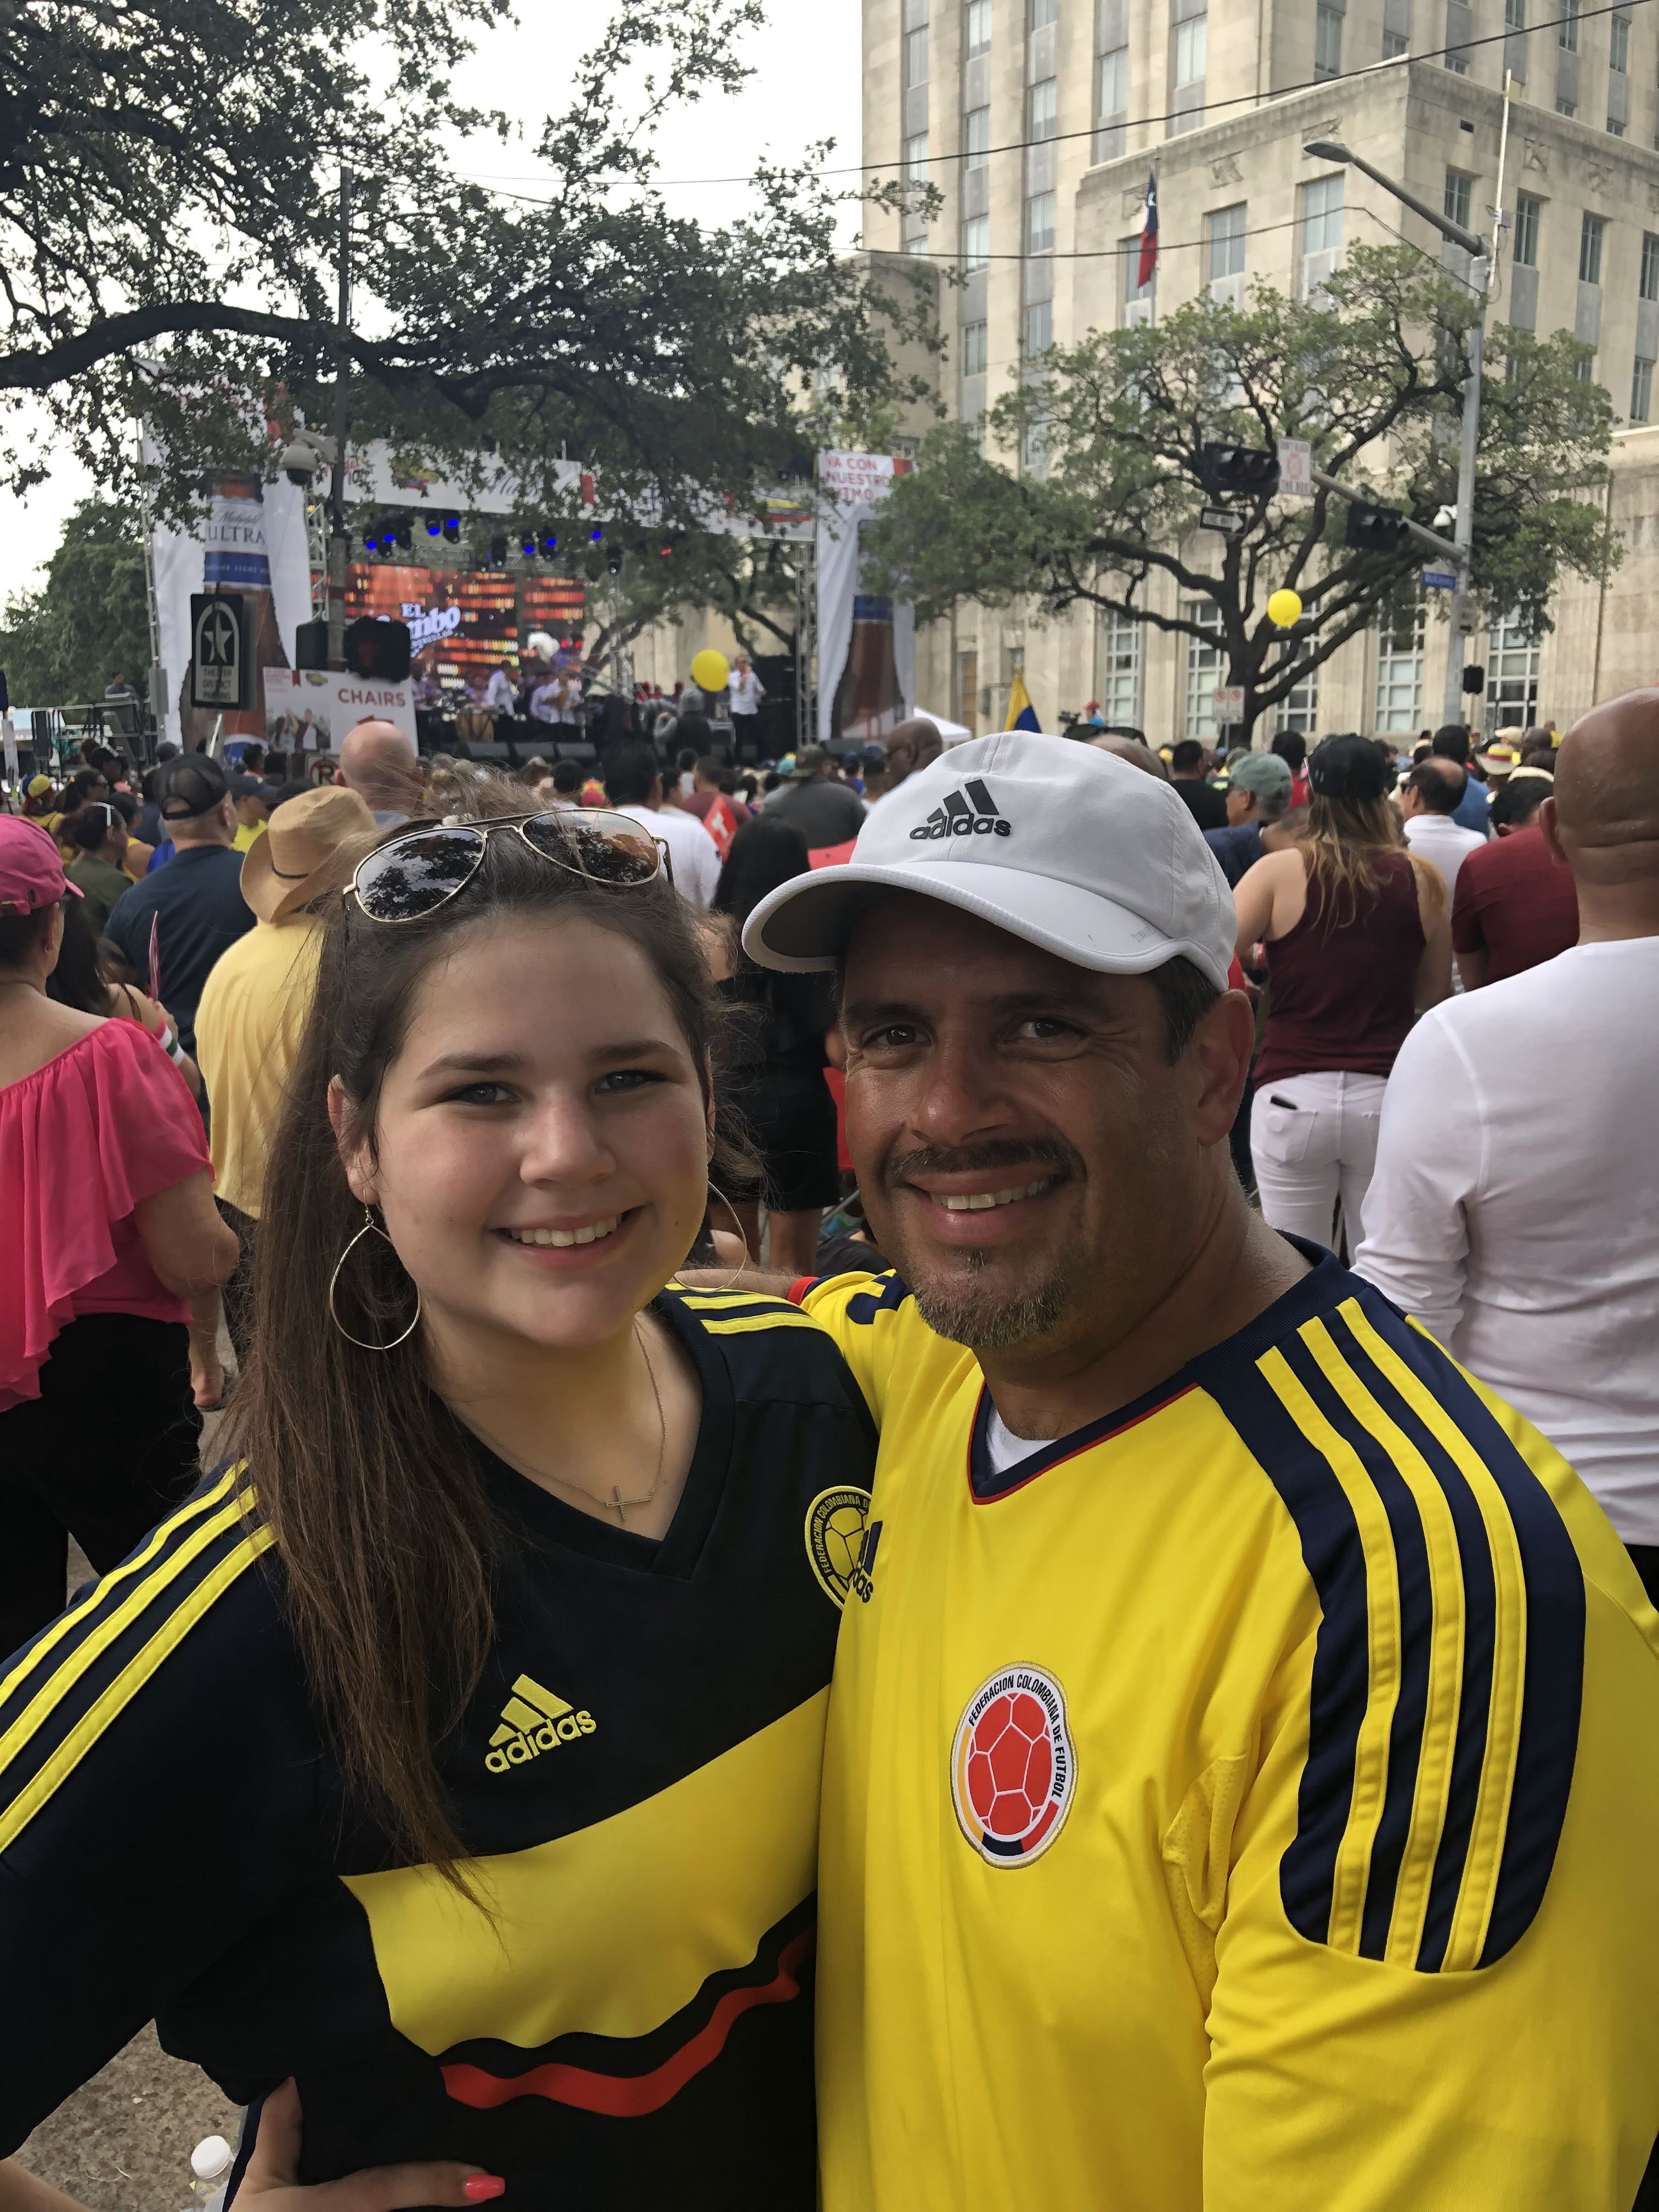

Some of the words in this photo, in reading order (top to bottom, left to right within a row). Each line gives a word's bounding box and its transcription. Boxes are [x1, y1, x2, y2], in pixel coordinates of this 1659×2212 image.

[847, 457, 878, 471] CON
[206, 525, 266, 545] ULTRA
[401, 602, 426, 618] EL
[338, 687, 406, 708] CHAIRS
[910, 812, 1011, 839] adidas
[817, 1494, 861, 1519] COLOMBIANA
[814, 1516, 832, 1574] FEDERACION
[968, 1674, 1014, 1726] FEDERACION
[1017, 1674, 1060, 1725] COLOMBIANA
[485, 1711, 597, 1773] adidas
[1052, 1724, 1063, 1743] DE
[1051, 1746, 1067, 1798] FUTBOL
